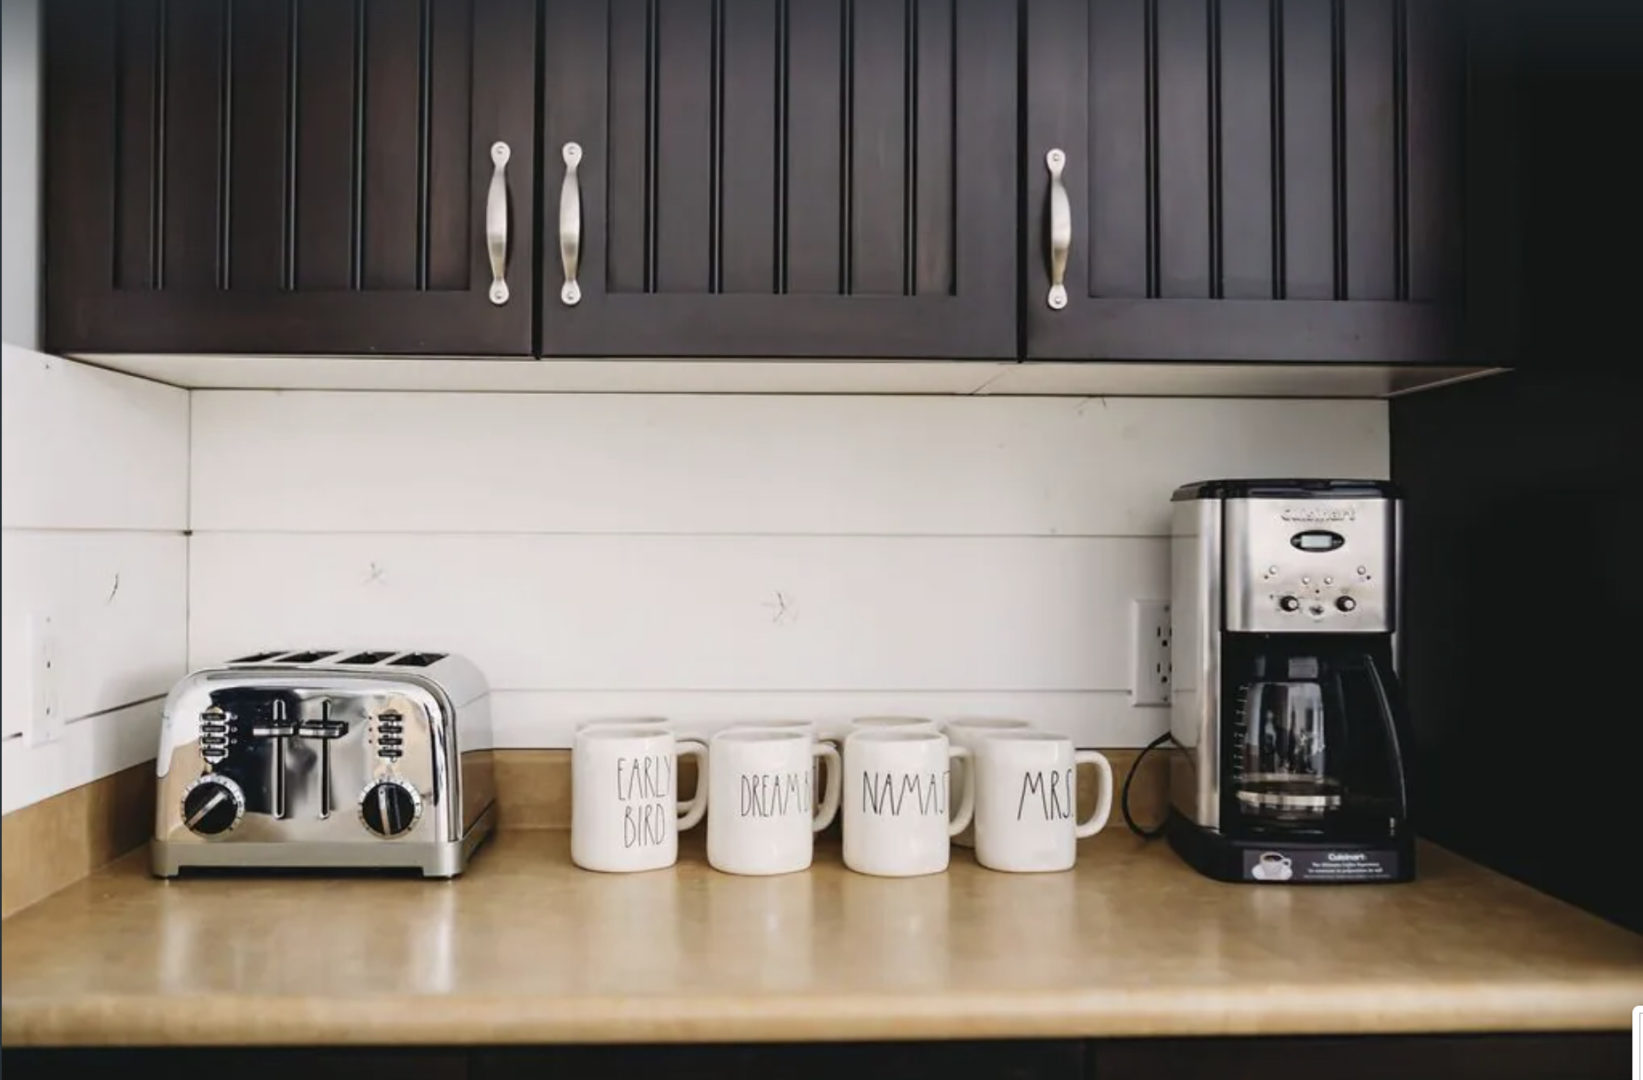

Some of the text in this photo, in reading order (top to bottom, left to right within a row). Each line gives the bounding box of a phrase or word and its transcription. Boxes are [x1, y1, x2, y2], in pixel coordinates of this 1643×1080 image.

[1280, 506, 1357, 522] Cuisinart
[617, 755, 672, 801] EARLY
[741, 773, 802, 818] DREAM
[624, 803, 665, 848] BIRD
[1328, 853, 1366, 862] Cuisinart
